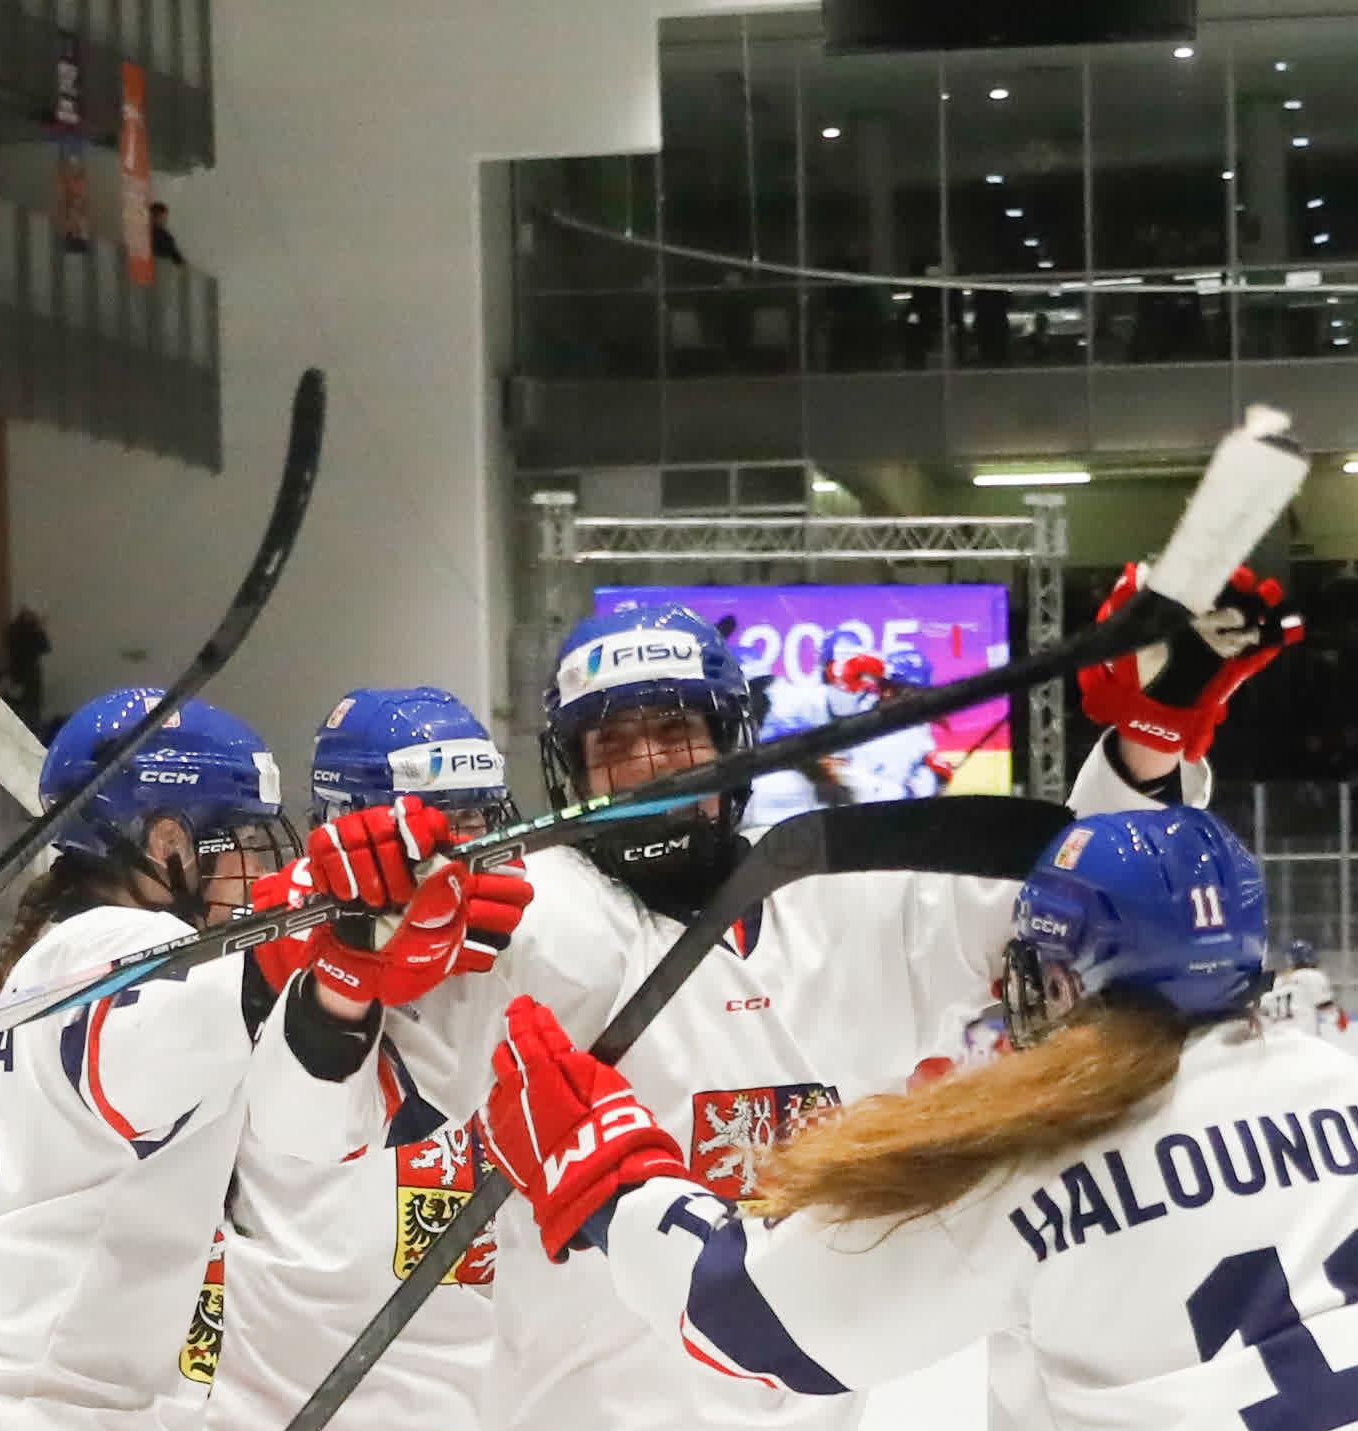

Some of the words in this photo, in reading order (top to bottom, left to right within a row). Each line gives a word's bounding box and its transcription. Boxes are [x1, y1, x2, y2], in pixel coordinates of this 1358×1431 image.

[613, 643, 693, 667] FISU
[450, 753, 504, 773] FIS
[140, 769, 200, 786] CCM
[313, 770, 341, 783] CCM
[198, 842, 235, 855] CCM
[623, 834, 691, 862] CCM
[1190, 884, 1225, 928] 11
[1031, 917, 1069, 937] CCM
[316, 957, 360, 988] CCM
